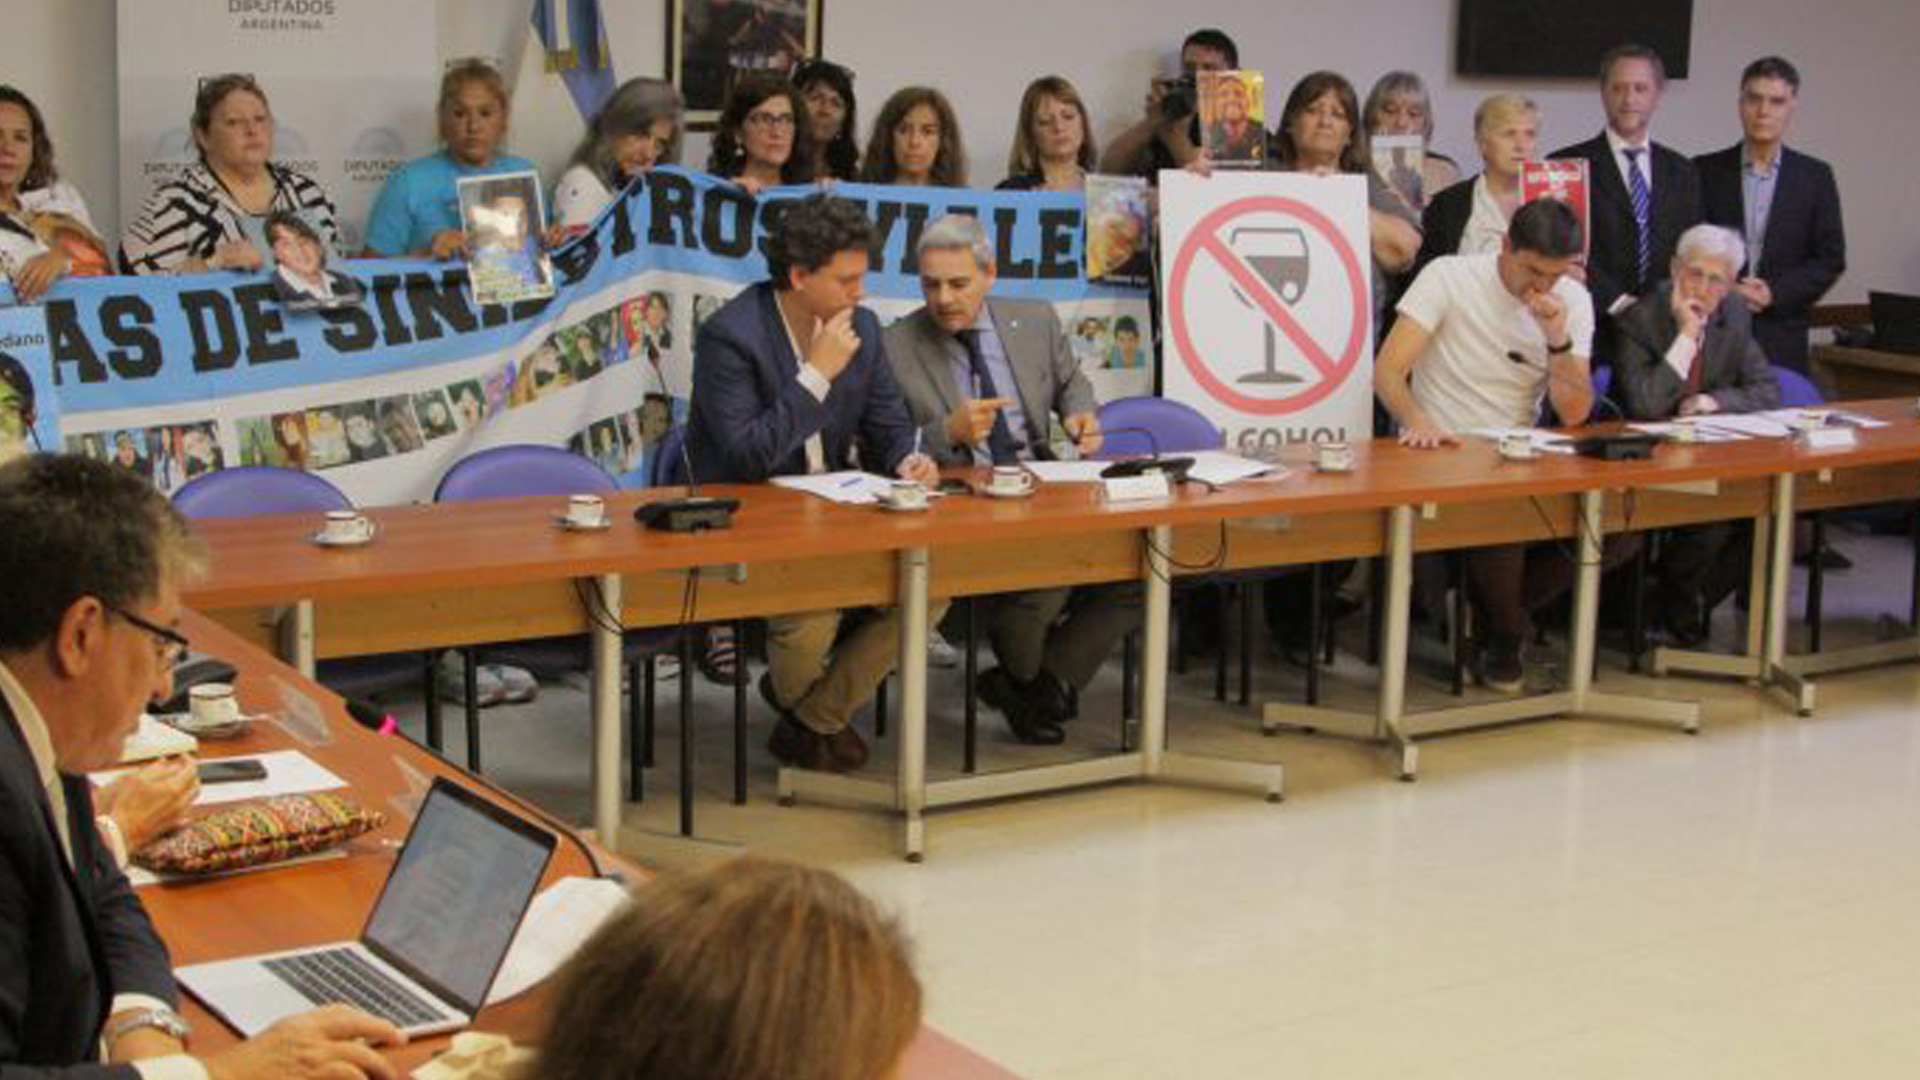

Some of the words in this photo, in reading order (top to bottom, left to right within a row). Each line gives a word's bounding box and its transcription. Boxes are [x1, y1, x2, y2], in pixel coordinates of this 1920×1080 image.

[228, 0, 335, 15] DIPUTADOS
[240, 19, 323, 31] ARGENTINA
[178, 284, 300, 374] DE
